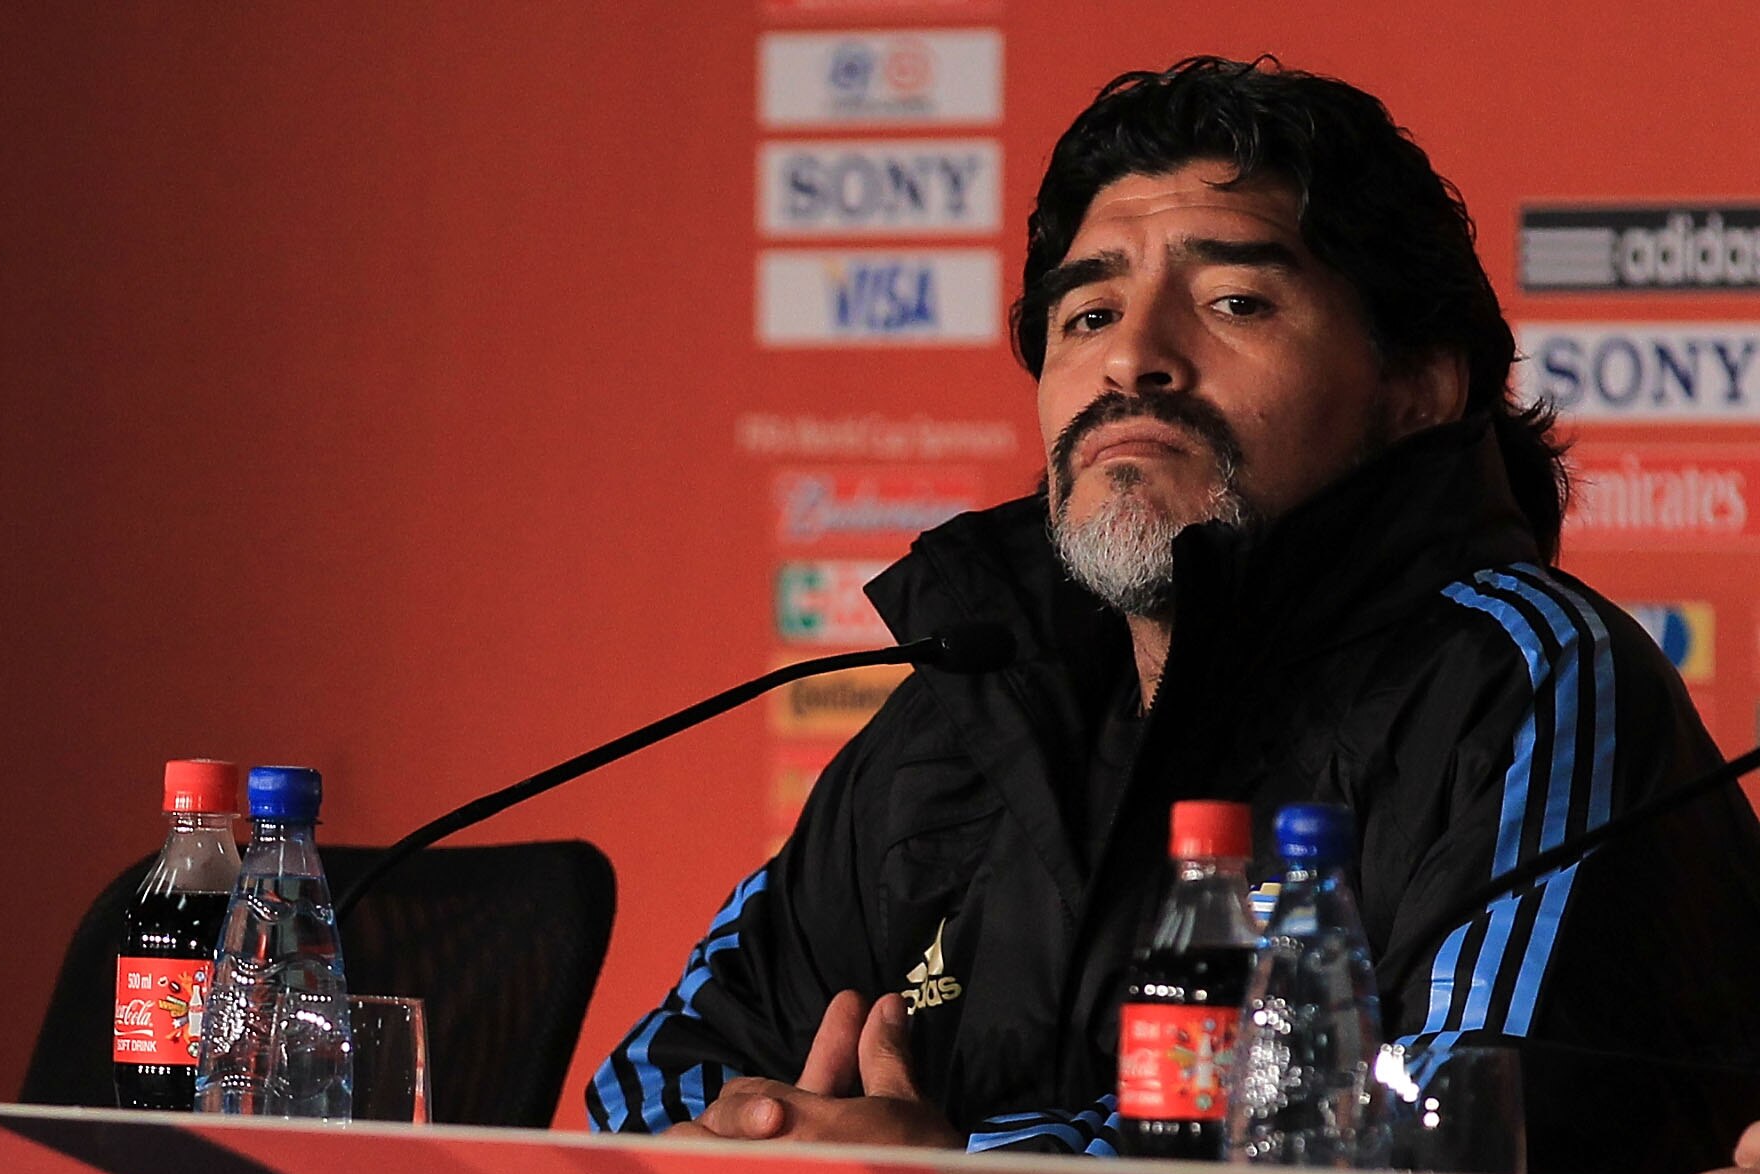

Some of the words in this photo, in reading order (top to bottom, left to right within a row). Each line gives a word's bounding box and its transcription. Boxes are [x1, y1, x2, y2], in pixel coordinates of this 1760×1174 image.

[783, 155, 982, 222] SONY
[1618, 211, 1760, 286] adida
[1542, 336, 1760, 406] SONY
[1562, 453, 1748, 530] mirates
[131, 1039, 157, 1052] DRINK
